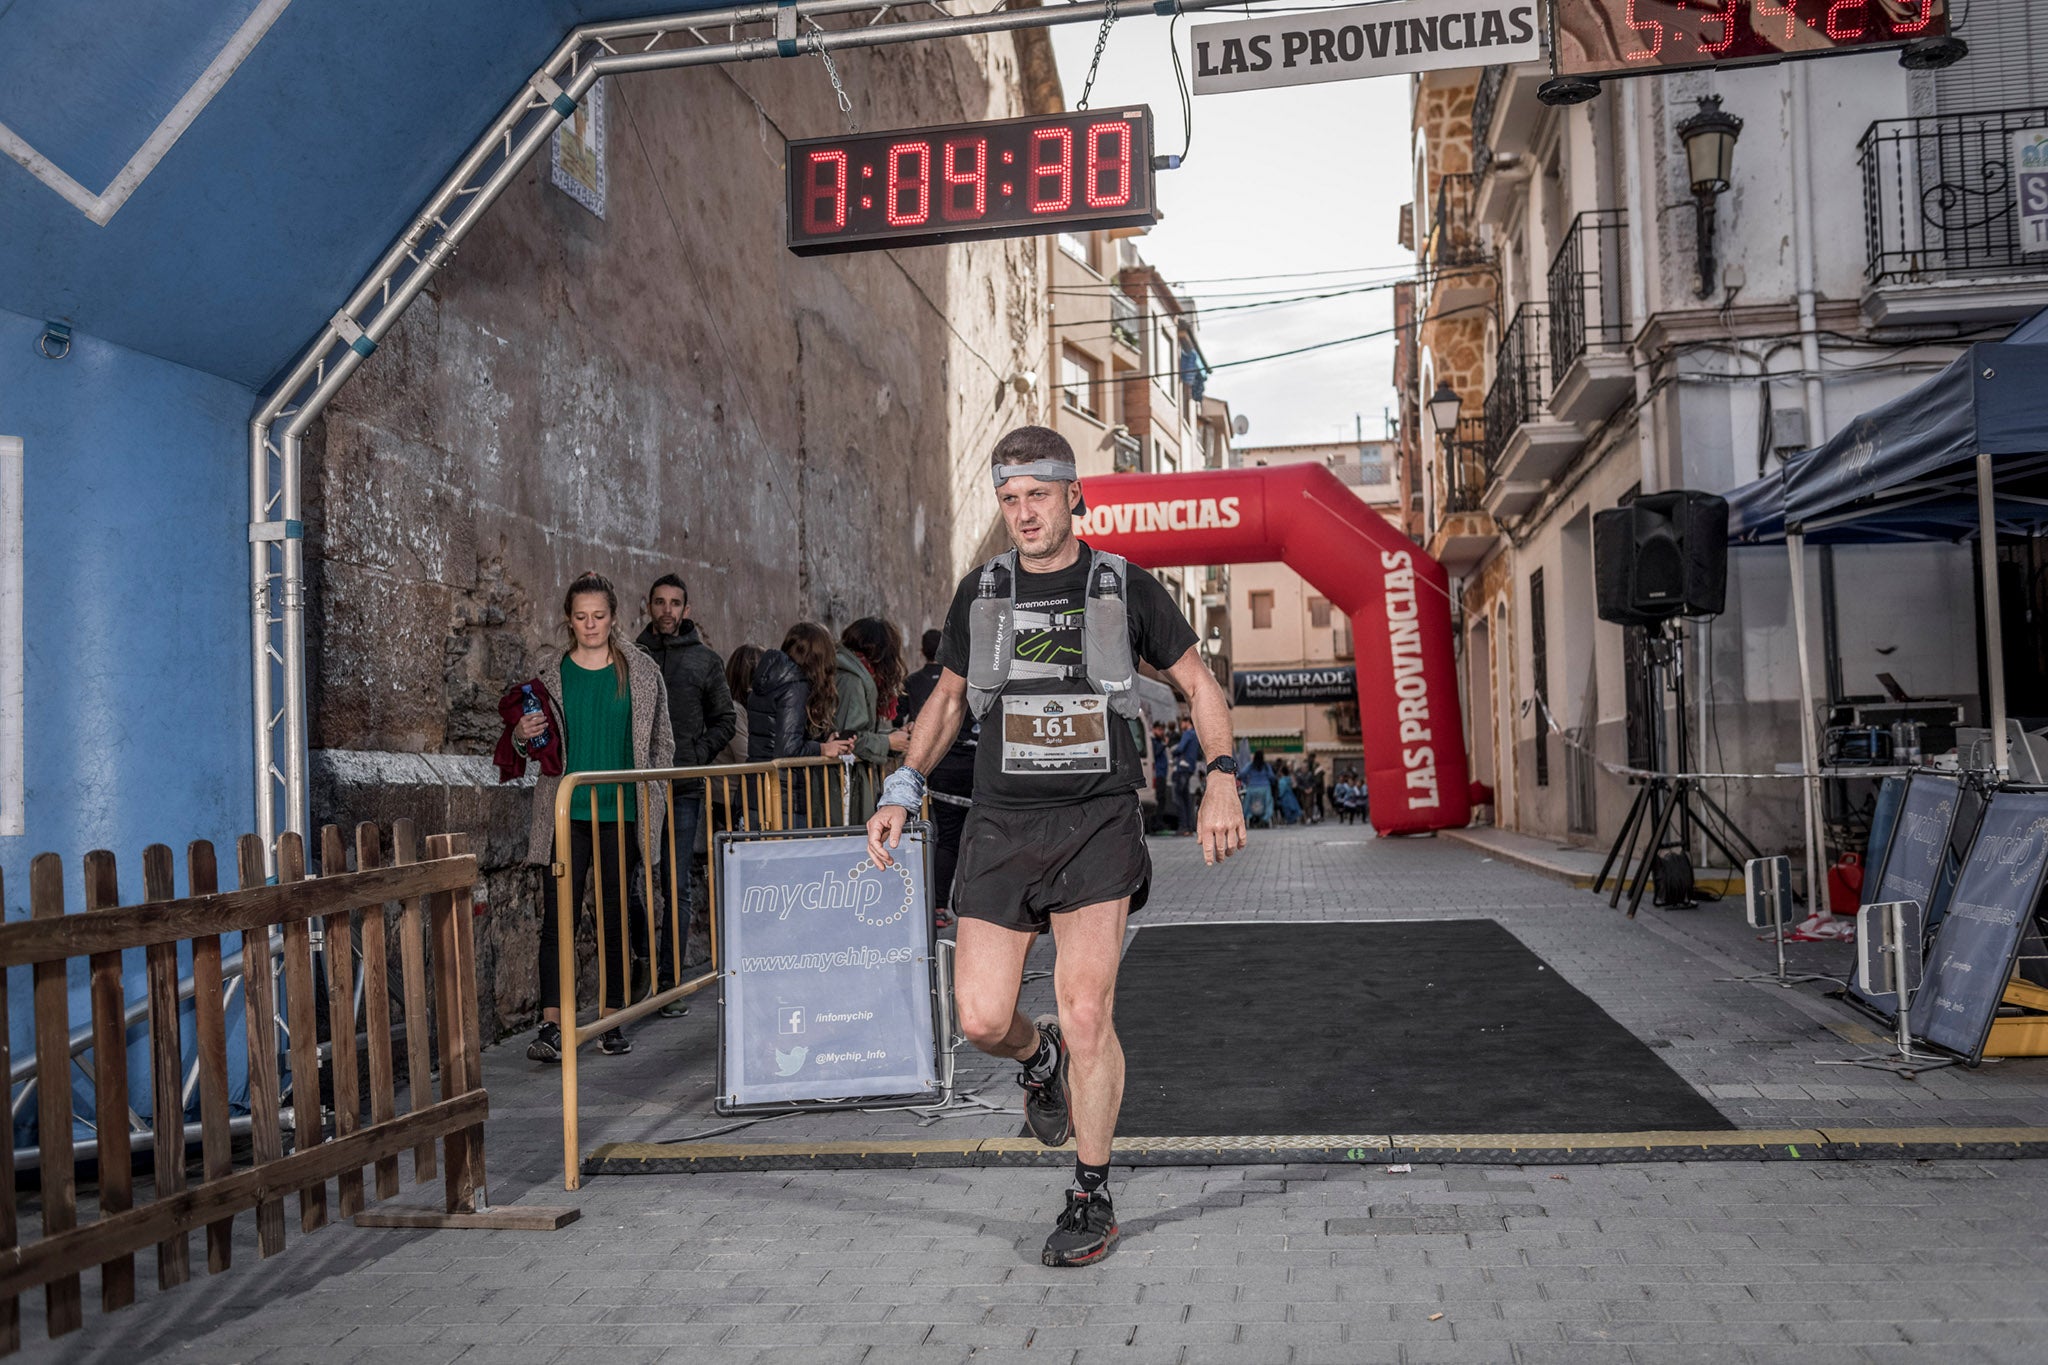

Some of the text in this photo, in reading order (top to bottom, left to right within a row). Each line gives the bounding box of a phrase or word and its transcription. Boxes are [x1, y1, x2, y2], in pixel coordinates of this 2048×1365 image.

[1197, 7, 1534, 77] LAS PROVINCIAS
[808, 121, 1132, 228] 7:04:30
[1072, 497, 1240, 536] ROVINCIAS
[1014, 598, 1069, 610] orremon.com
[1246, 684, 1352, 699] bebida para deportistas
[1381, 550, 1440, 810] LAS PROVINCIAS
[1032, 717, 1076, 737] 161
[742, 871, 882, 921] mychip
[742, 946, 912, 973] www.mychip.es
[815, 1010, 873, 1024] /infomychip
[815, 1050, 886, 1065] @Mychip_Info
